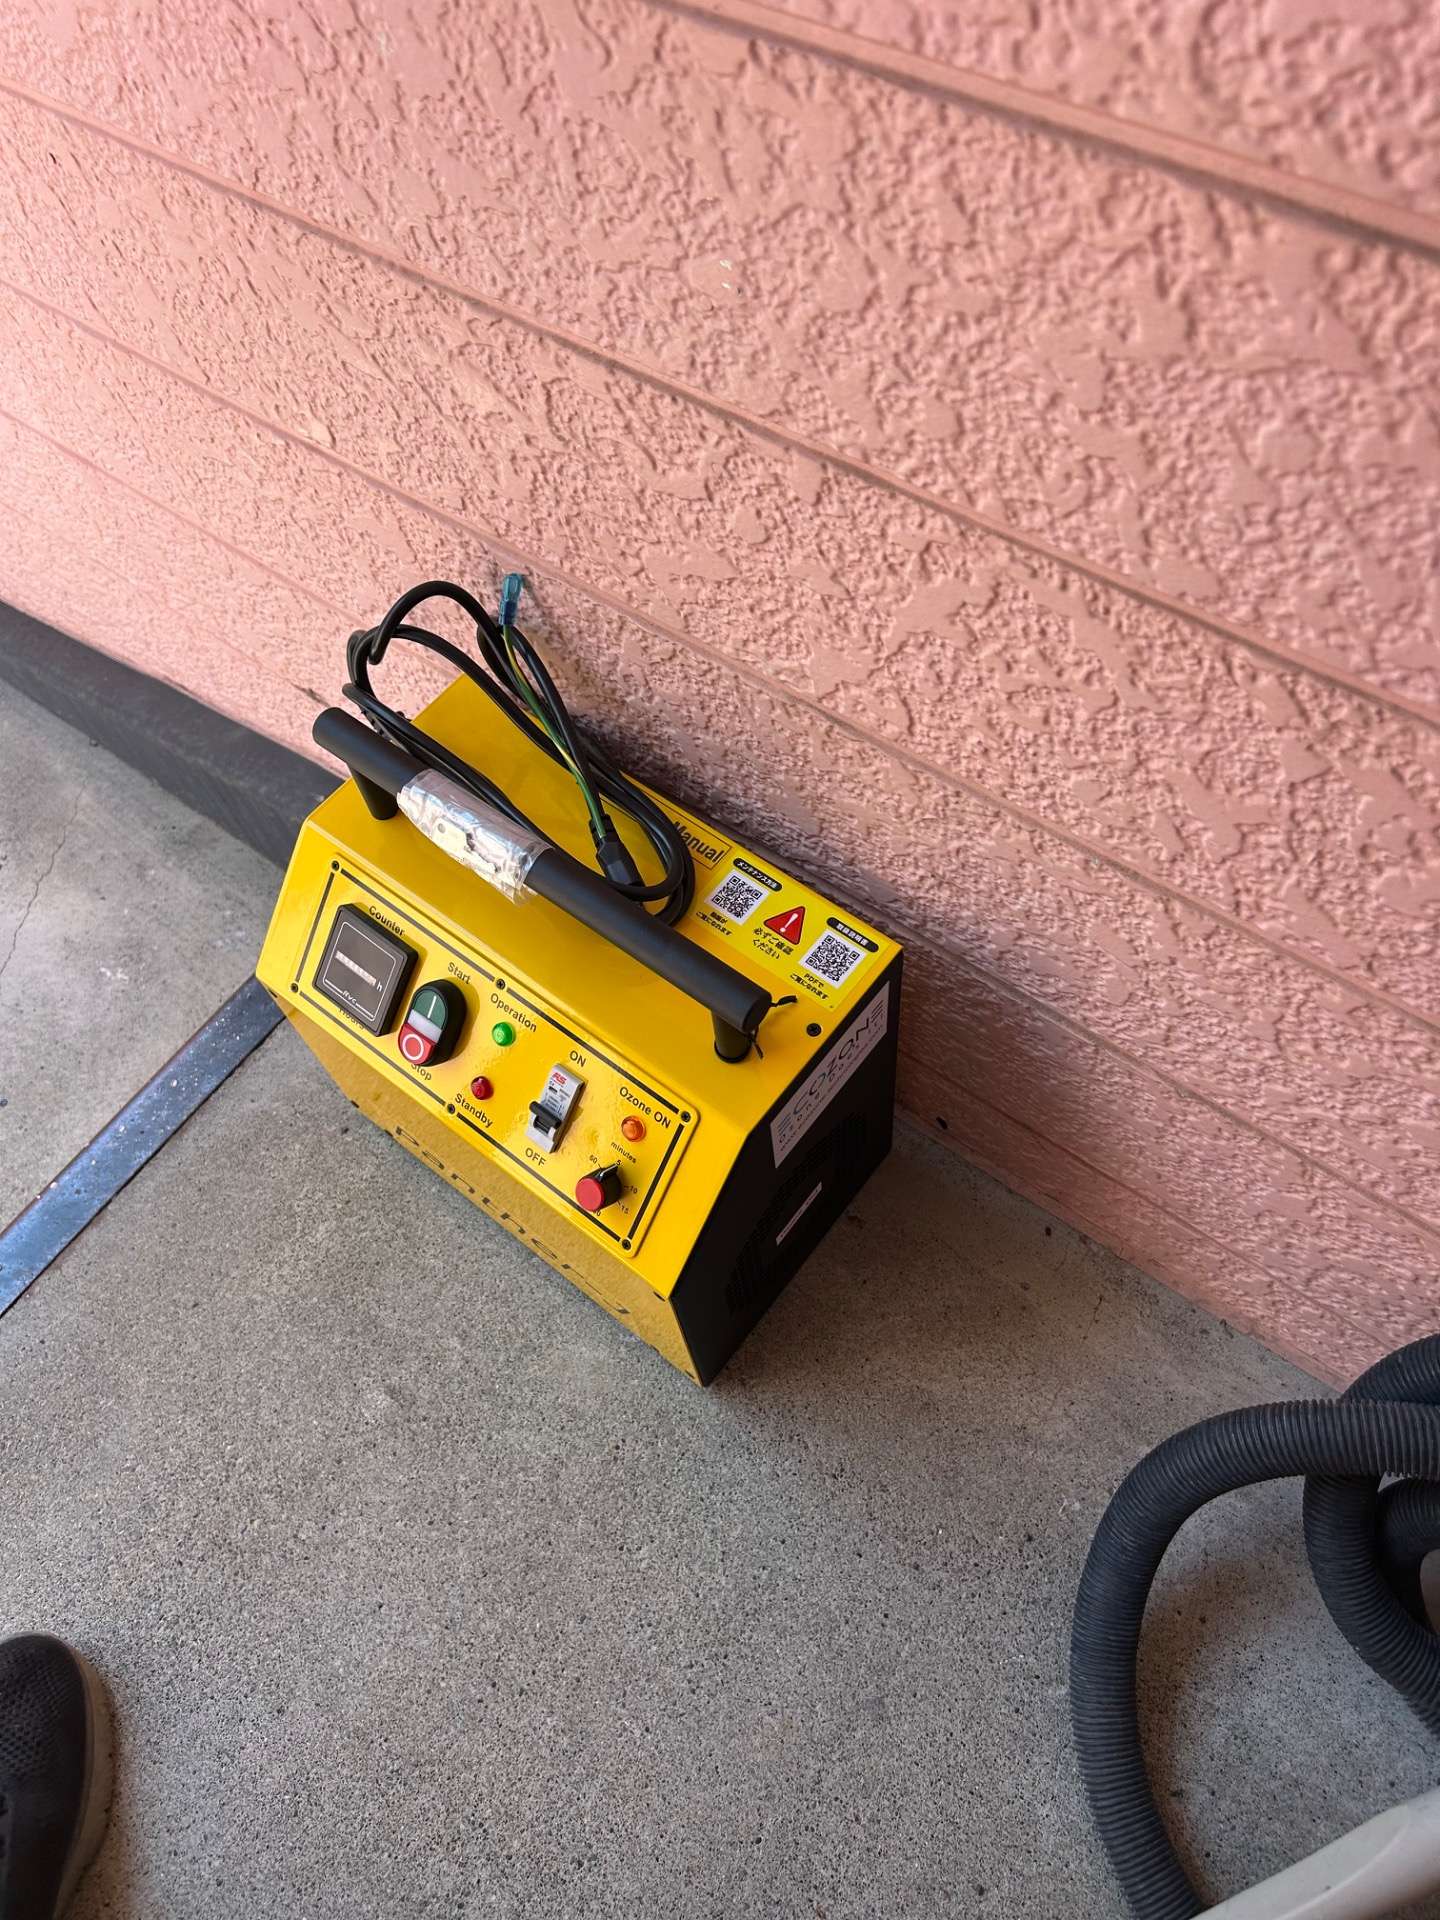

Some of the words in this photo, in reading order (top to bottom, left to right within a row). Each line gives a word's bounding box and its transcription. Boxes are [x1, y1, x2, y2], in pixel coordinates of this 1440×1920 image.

[369, 905, 405, 936] Counter
[753, 939, 780, 959] ください
[447, 962, 471, 985] Start
[804, 973, 825, 988] PDFで
[490, 992, 537, 1033] Operation
[569, 1050, 587, 1068] ON
[454, 1093, 493, 1128] Standby
[619, 1086, 652, 1116] Ozone
[654, 1110, 671, 1129] ON
[525, 1147, 547, 1167] OFF
[610, 1142, 637, 1164] minutes
